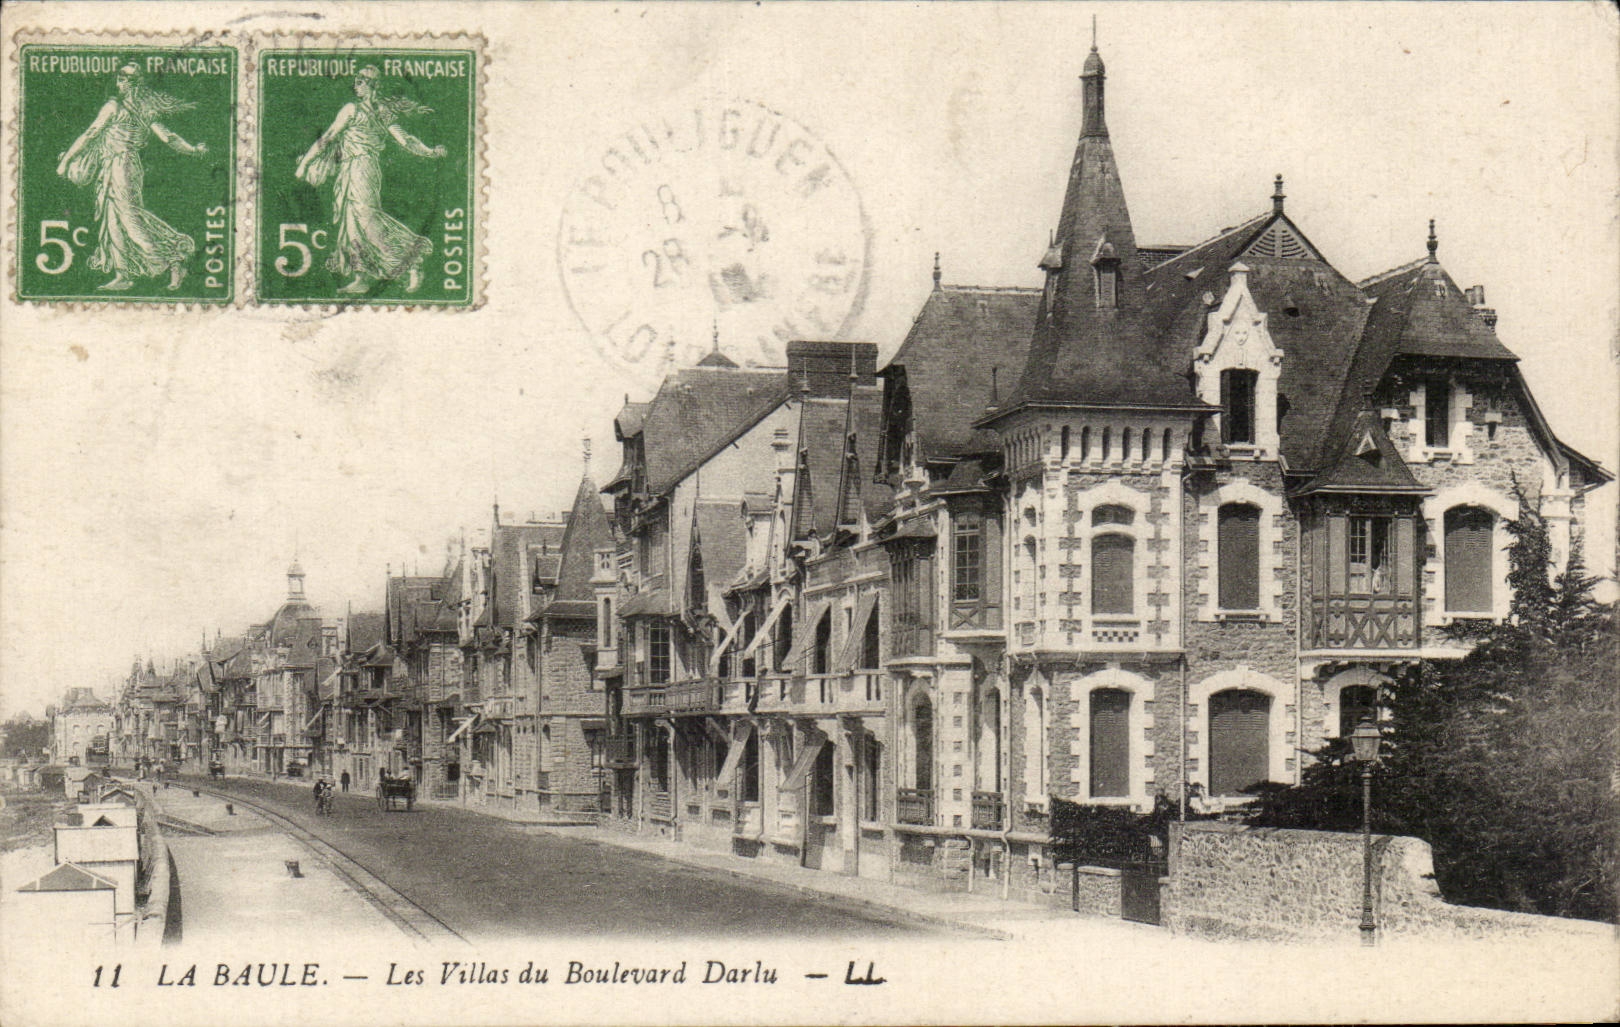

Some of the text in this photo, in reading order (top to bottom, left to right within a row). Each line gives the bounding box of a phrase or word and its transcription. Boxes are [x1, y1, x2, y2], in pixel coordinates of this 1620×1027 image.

[146, 57, 228, 77] FRANÇAISE
[384, 59, 466, 79] FRANÇAISE
[205, 205, 226, 288] POSTES
[443, 207, 465, 290] POSTES
